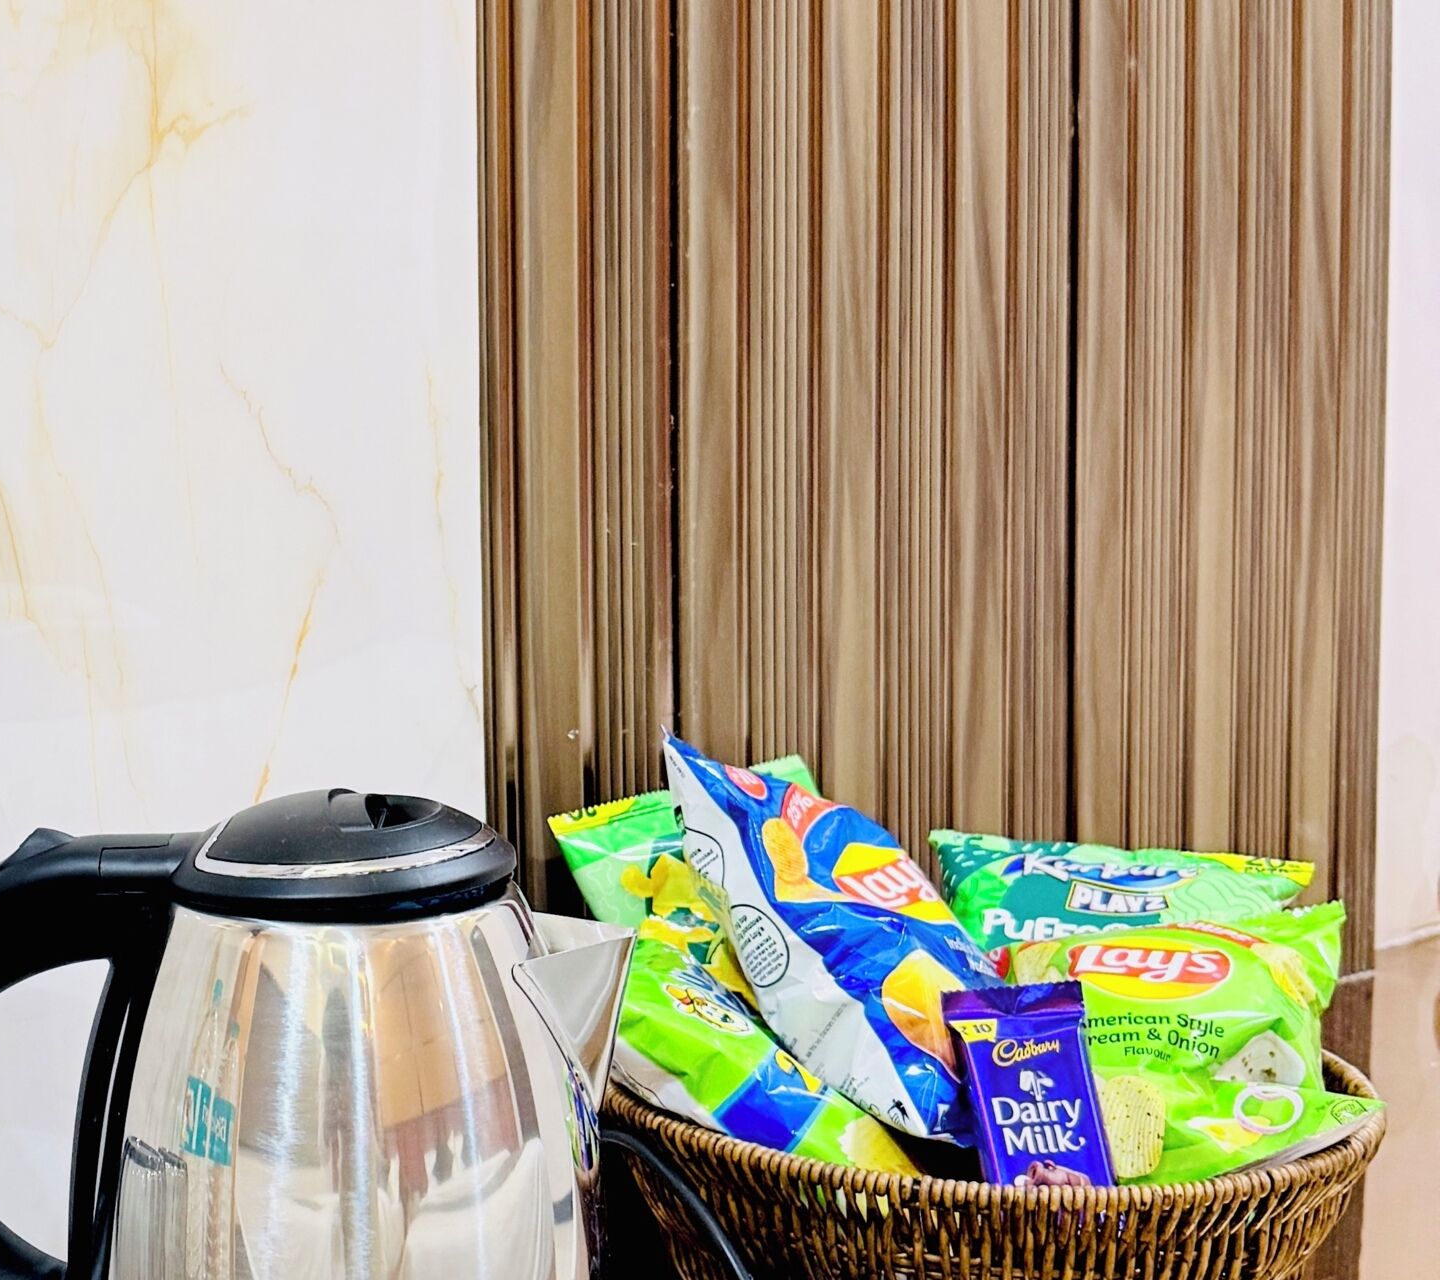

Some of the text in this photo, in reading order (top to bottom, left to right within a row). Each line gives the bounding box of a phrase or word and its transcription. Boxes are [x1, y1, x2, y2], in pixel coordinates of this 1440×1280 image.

[1071, 885, 1166, 913] PLAYZ
[1071, 945, 1218, 983] Lay's
[972, 1023, 992, 1033] 10
[1176, 1013, 1225, 1038] Style
[992, 1039, 1060, 1067] Cadbury
[1089, 1028, 1220, 1059] ream & Onion
[991, 1096, 1081, 1129] Dairy
[1003, 1124, 1086, 1156] Milk
